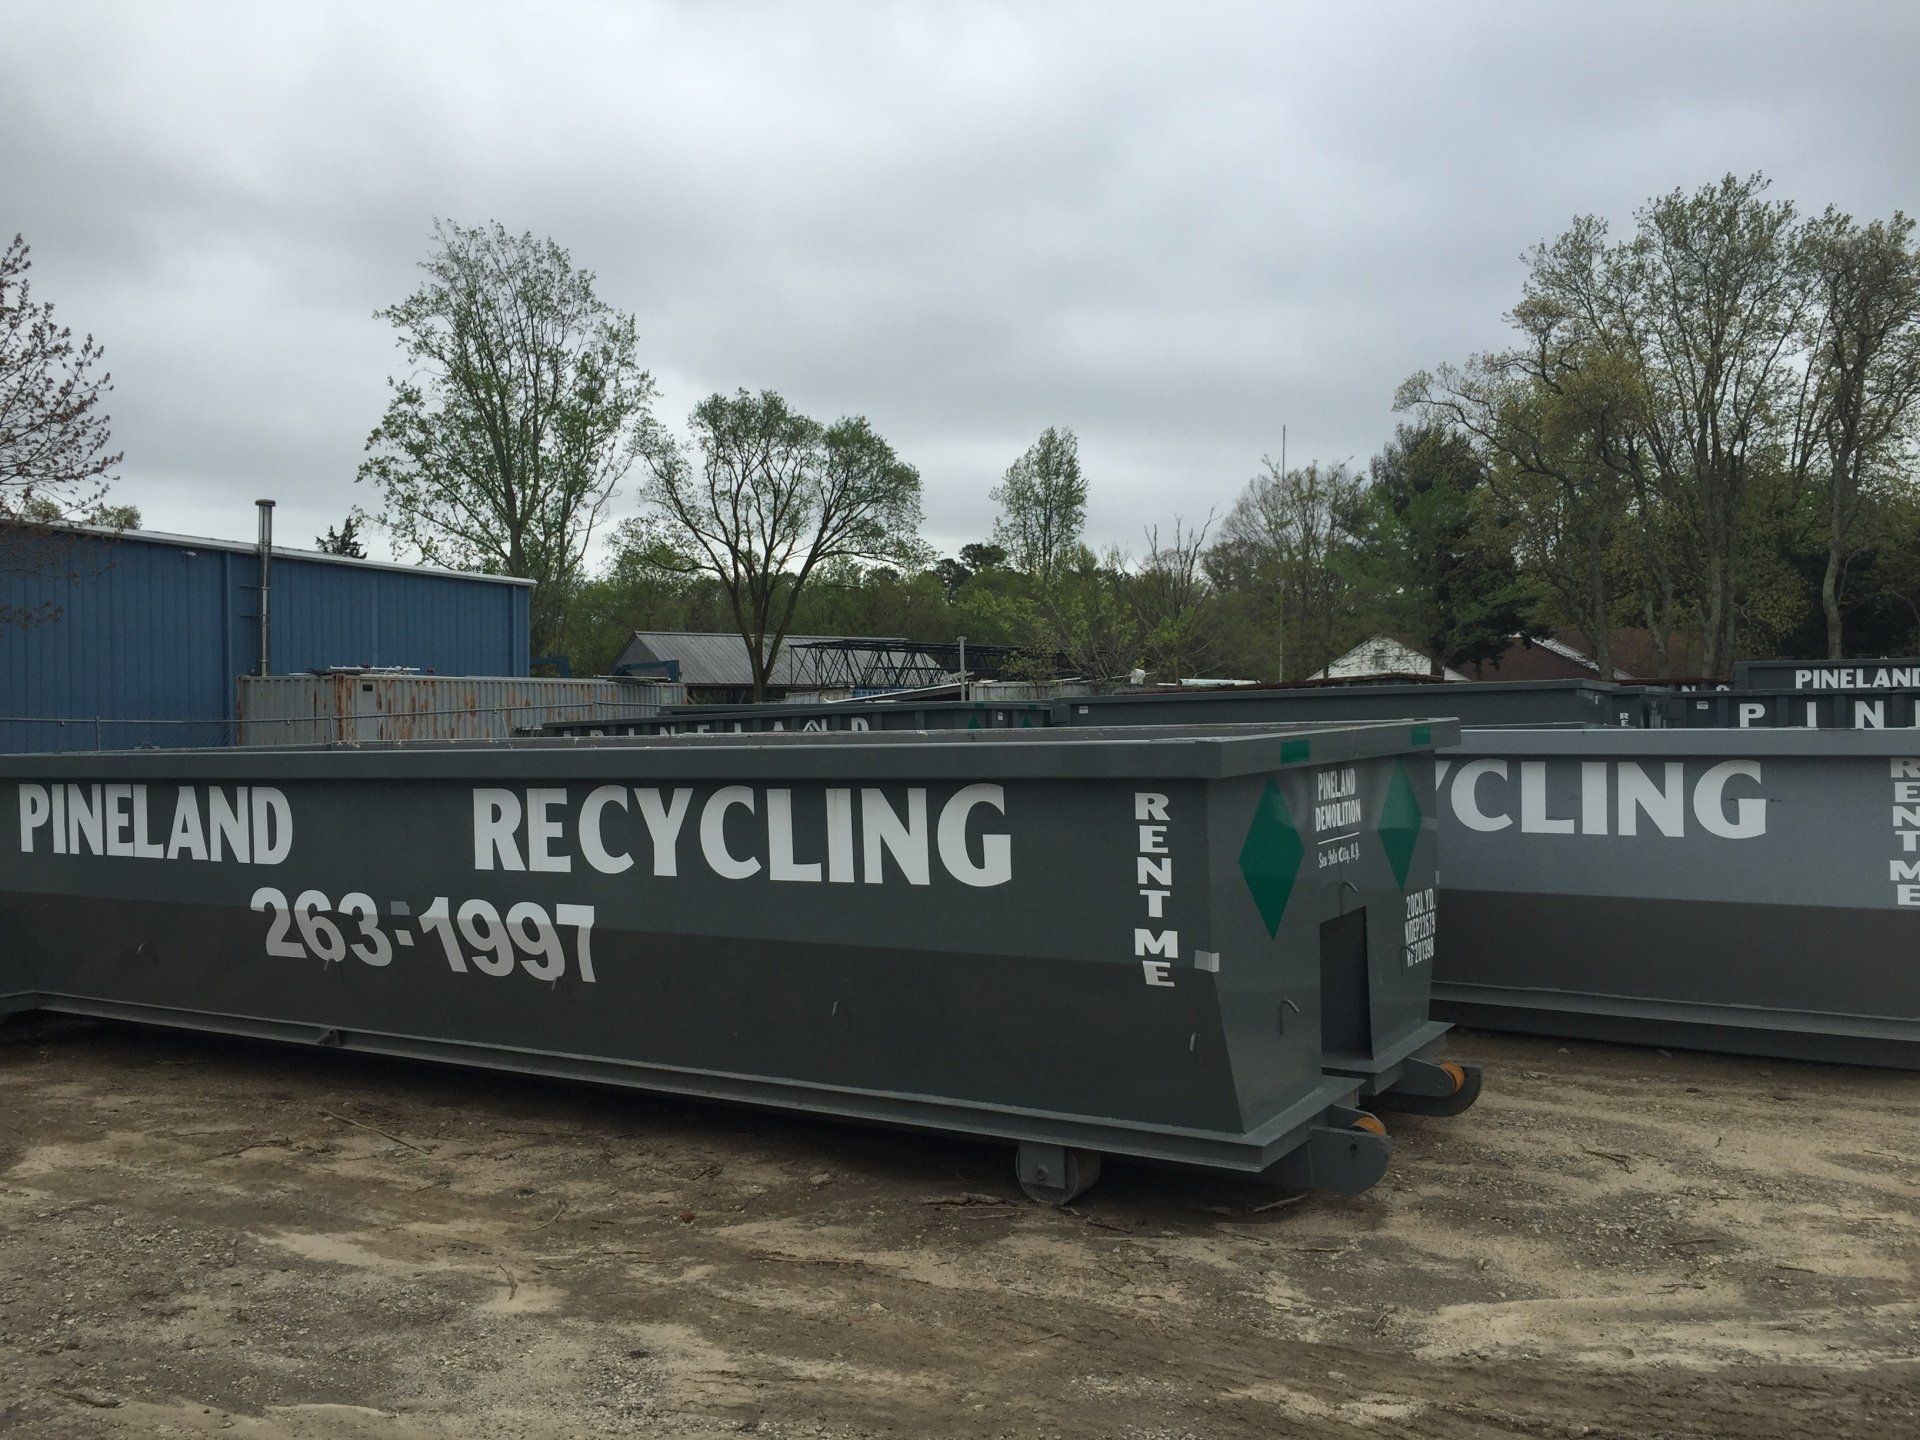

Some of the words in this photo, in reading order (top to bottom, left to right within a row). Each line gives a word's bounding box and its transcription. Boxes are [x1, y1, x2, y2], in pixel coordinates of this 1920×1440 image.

[1315, 799, 1361, 832] DEMOLITION
[1318, 768, 1355, 801] PINELAND
[19, 784, 293, 864] PINELAND
[472, 783, 1012, 887] RECYCLING
[1134, 792, 1171, 918] RENT
[250, 887, 597, 983] 263-1997
[1134, 928, 1178, 987] ME
